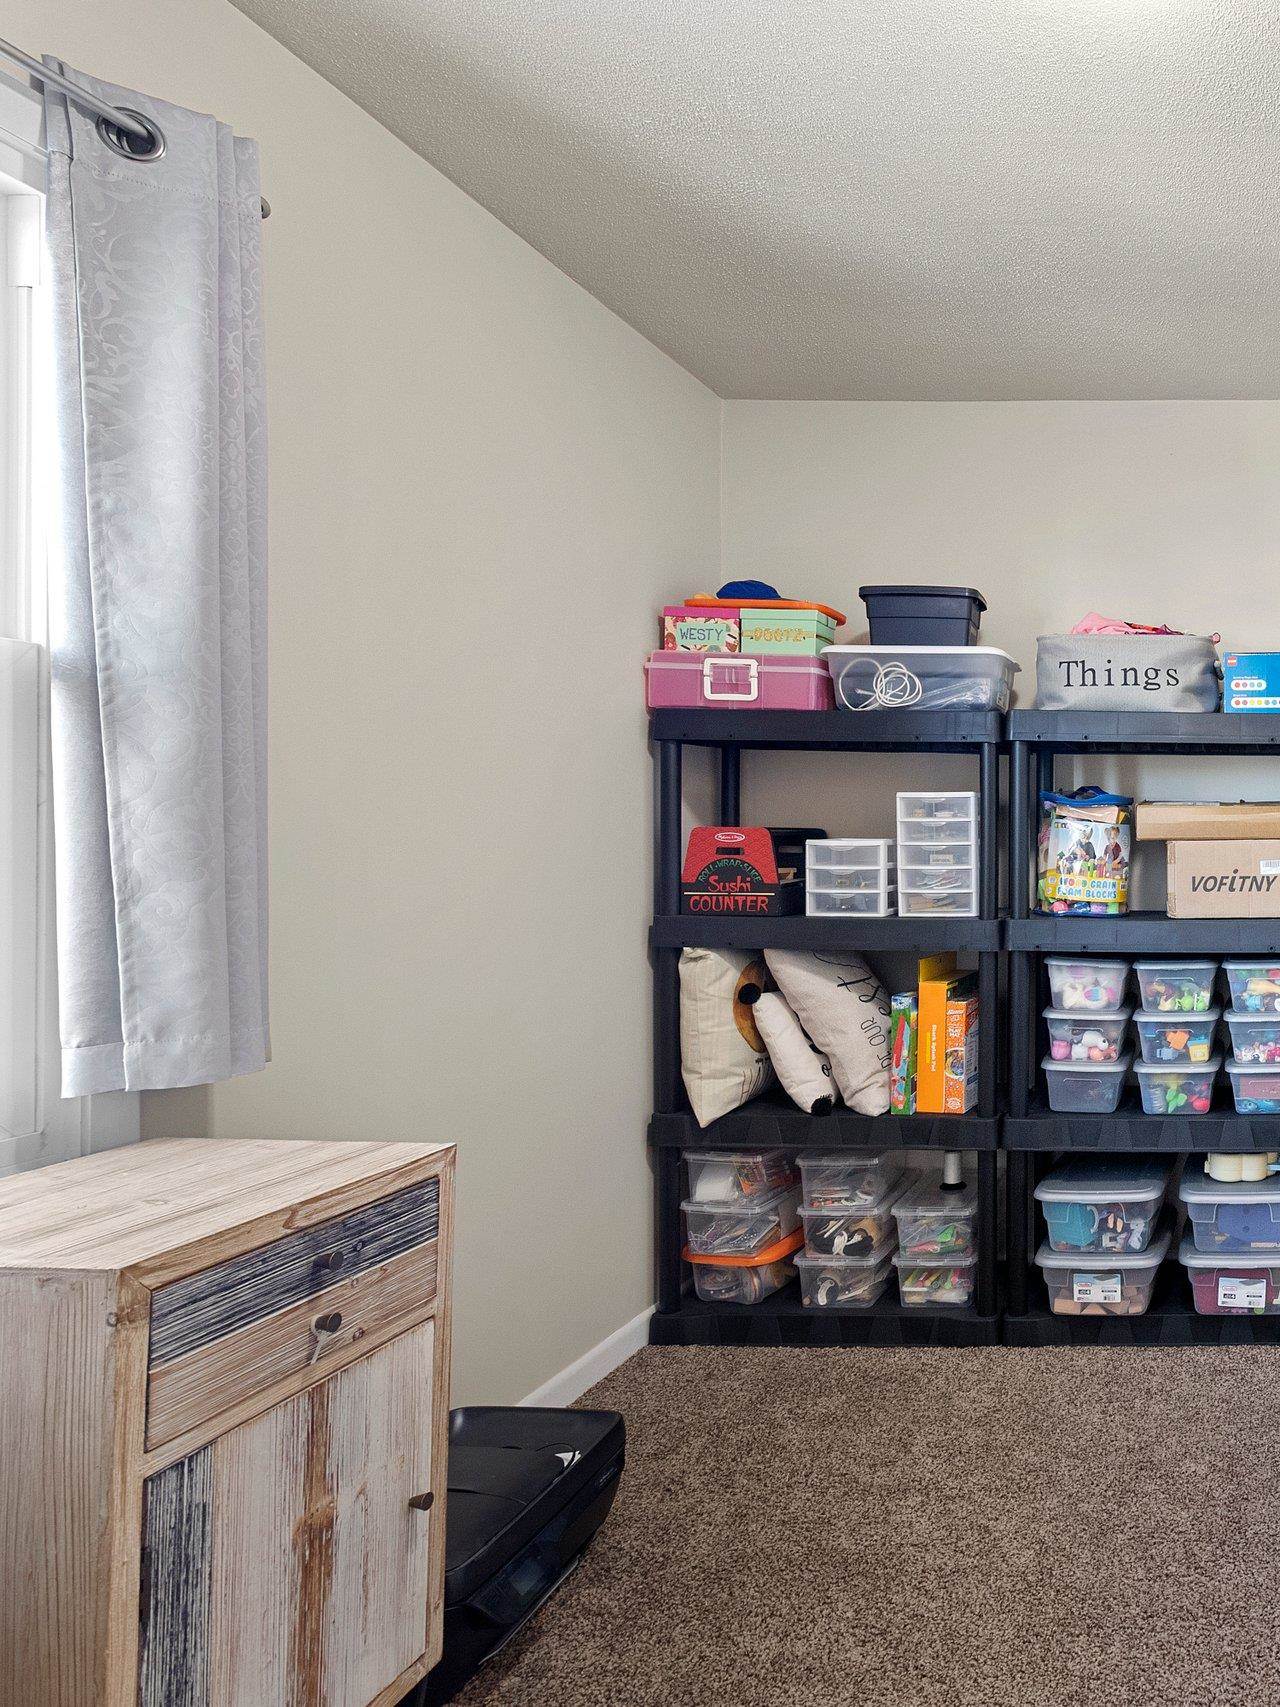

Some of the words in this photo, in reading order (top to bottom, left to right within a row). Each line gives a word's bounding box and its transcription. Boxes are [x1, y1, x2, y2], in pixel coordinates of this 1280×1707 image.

[679, 627, 724, 641] WESTY
[1058, 659, 1180, 691] Things
[708, 875, 751, 892] Sushi
[1090, 880, 1117, 890] GRAIN
[1085, 889, 1117, 899] BLOCKS
[690, 895, 769, 912] COUNTER
